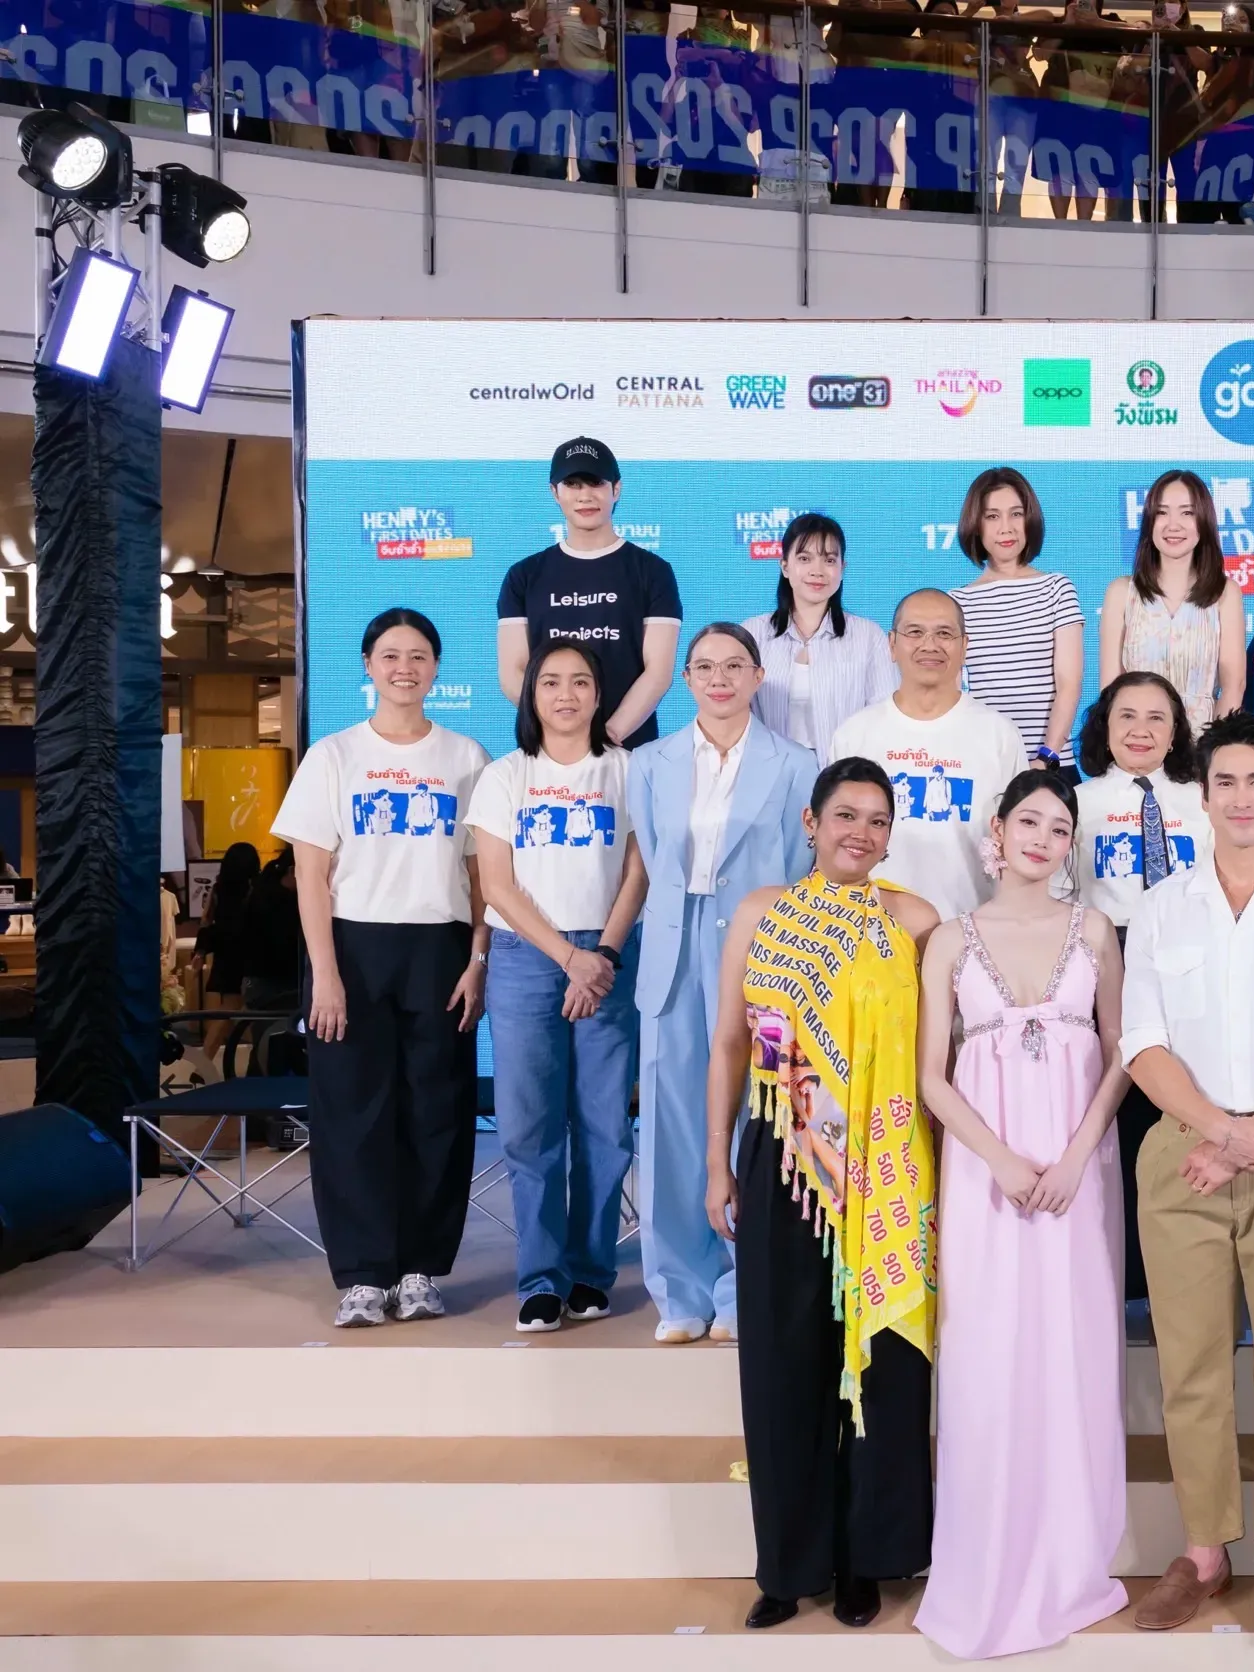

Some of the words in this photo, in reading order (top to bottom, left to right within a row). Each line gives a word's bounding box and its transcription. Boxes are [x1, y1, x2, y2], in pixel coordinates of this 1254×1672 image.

[470, 383, 594, 400] centralwOrld
[616, 377, 704, 390] CENTRAL
[726, 376, 787, 392] GREEN
[915, 380, 1002, 393] THAILAND
[618, 394, 704, 408] PATTANA
[729, 392, 786, 409] WAVE
[1033, 387, 1082, 399] oppo
[410, 528, 453, 541] DATES
[921, 523, 957, 550] 17
[551, 592, 618, 607] Leisure
[797, 914, 820, 932] OIL
[747, 970, 808, 1009] COCONUT
[803, 1006, 850, 1085] MASSAGE
[889, 1094, 907, 1128] 250
[878, 1152, 896, 1186] 500
[889, 1195, 911, 1228] 700
[867, 1208, 888, 1242] 700
[882, 1253, 906, 1285] 900
[861, 1266, 885, 1306] 1050
